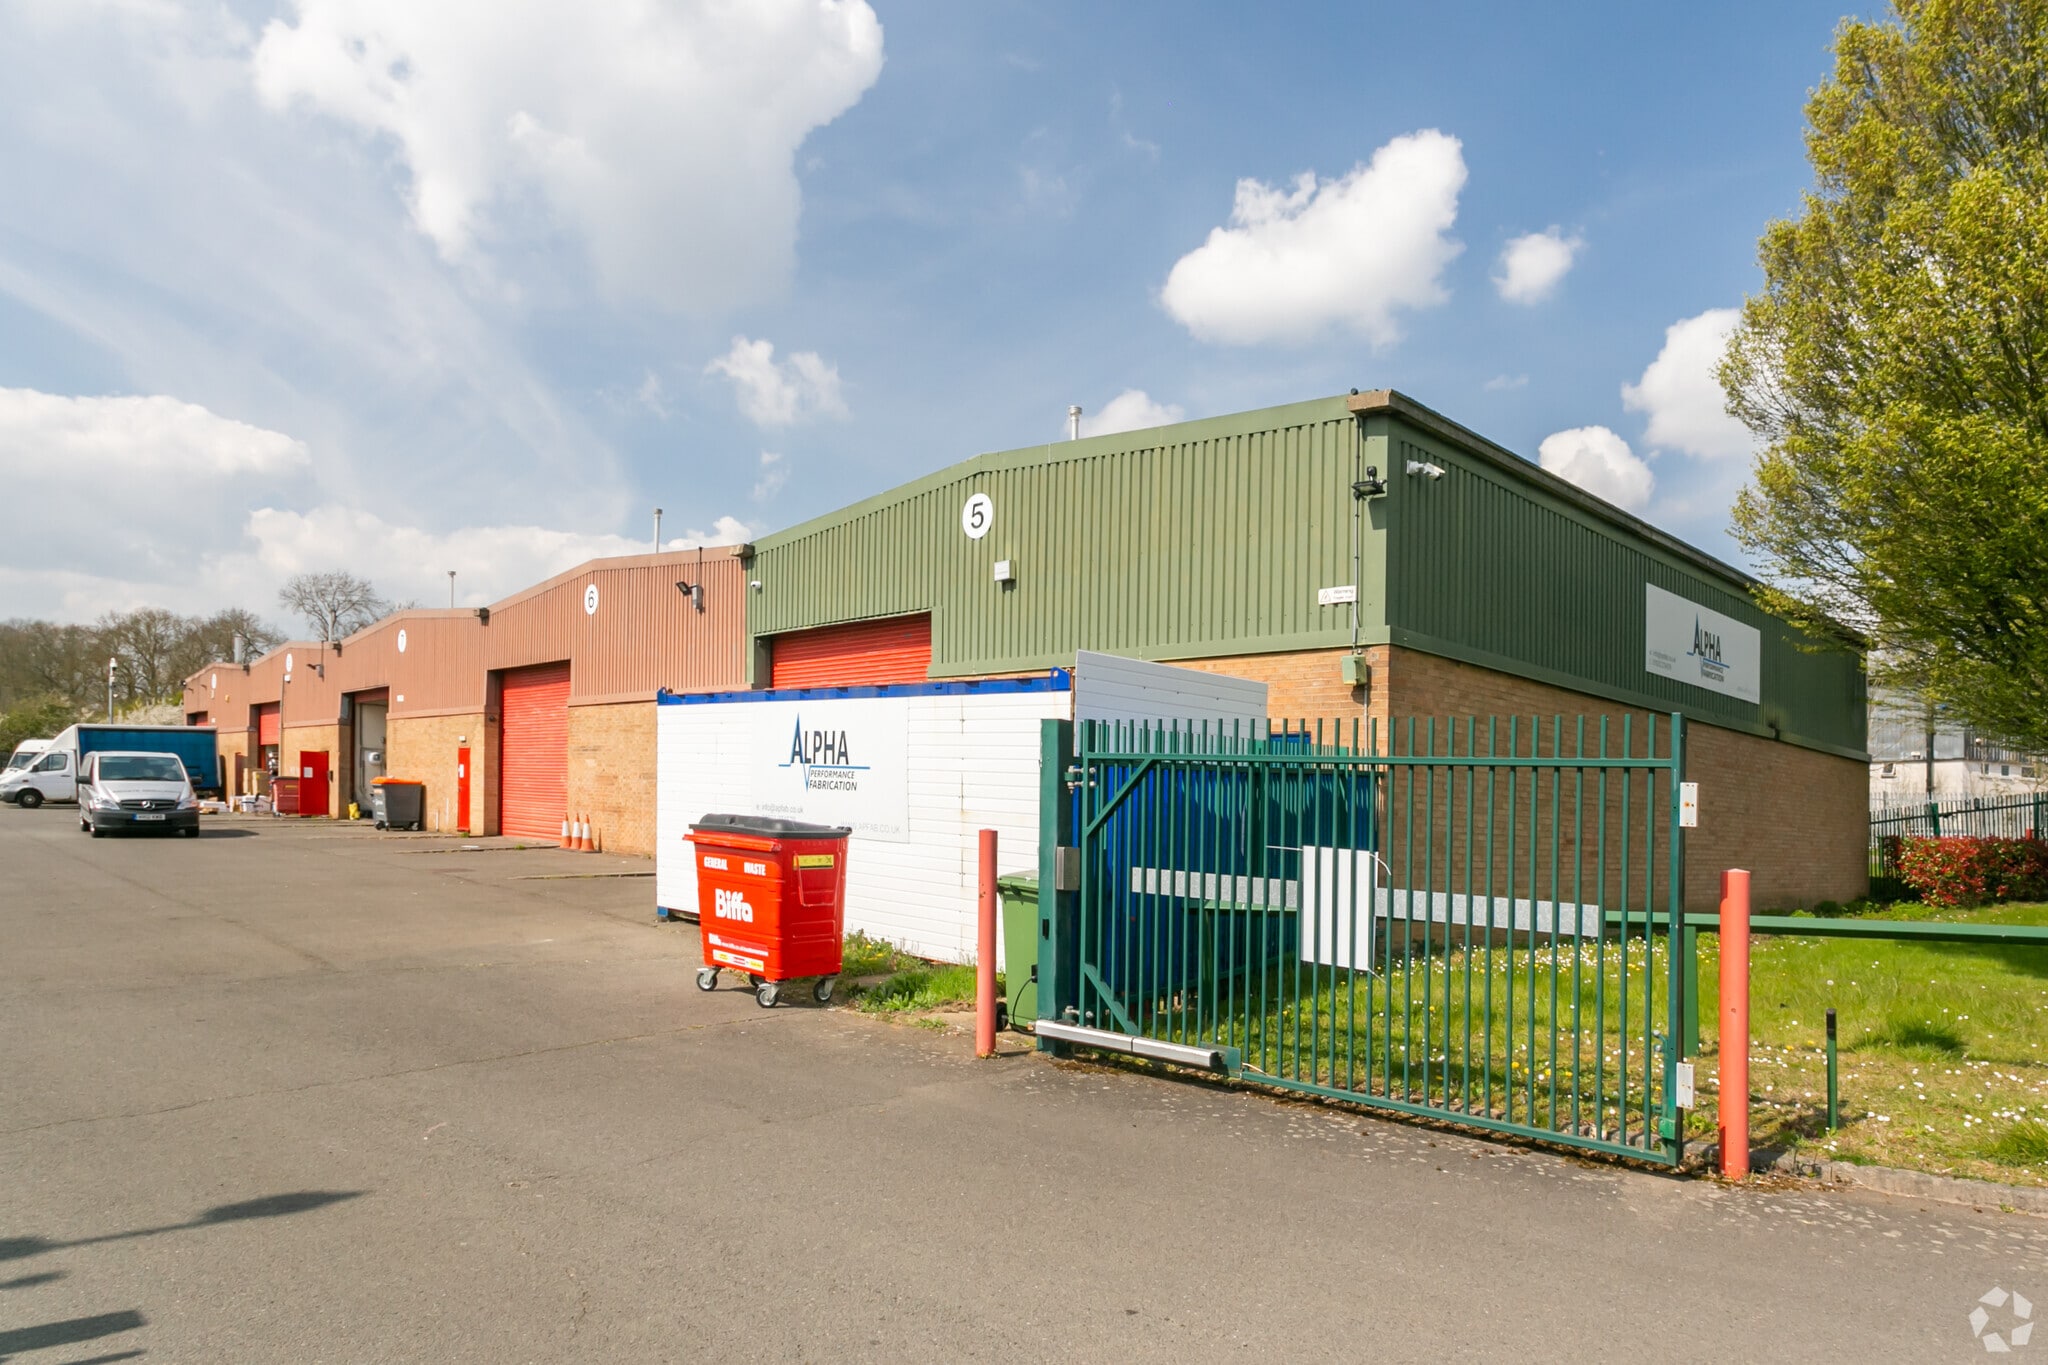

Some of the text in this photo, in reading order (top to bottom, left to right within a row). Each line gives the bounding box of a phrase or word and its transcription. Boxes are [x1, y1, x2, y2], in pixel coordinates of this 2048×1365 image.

[971, 502, 984, 529] 5
[588, 590, 595, 608] 6
[1693, 612, 1722, 663] ALPHA
[790, 712, 849, 765] ALPHA
[809, 779, 858, 791] FABRICATION
[810, 769, 855, 779] PERFORMANCE
[704, 856, 766, 876] GENERAL WASTE
[715, 888, 753, 922] Biffa
